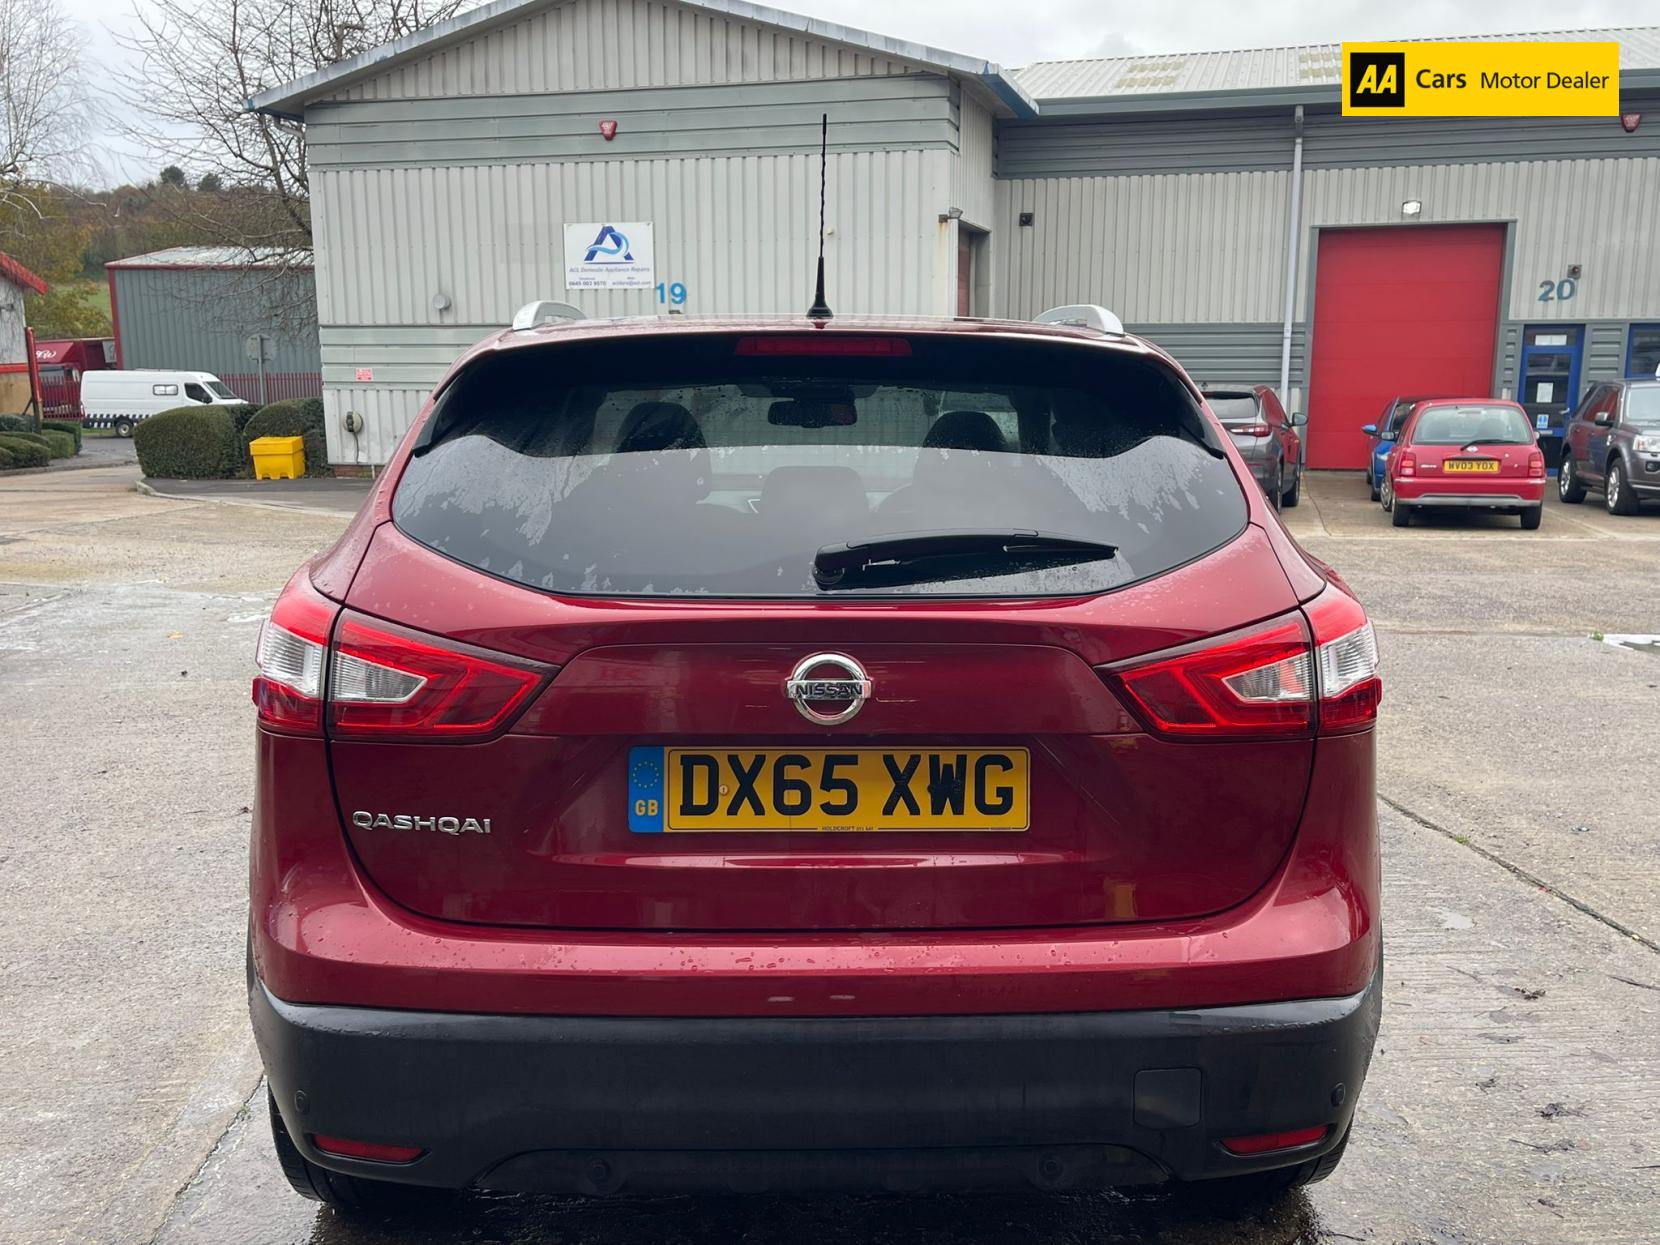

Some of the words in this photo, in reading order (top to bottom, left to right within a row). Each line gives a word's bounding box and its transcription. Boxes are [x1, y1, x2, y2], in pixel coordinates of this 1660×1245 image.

[656, 282, 687, 305] 19
[1538, 279, 1576, 302] 20
[795, 684, 863, 696] NISSAN
[679, 754, 858, 816] DX65
[881, 754, 1014, 816] XWG
[635, 799, 659, 817] GB
[352, 810, 491, 836] QASHQAI
